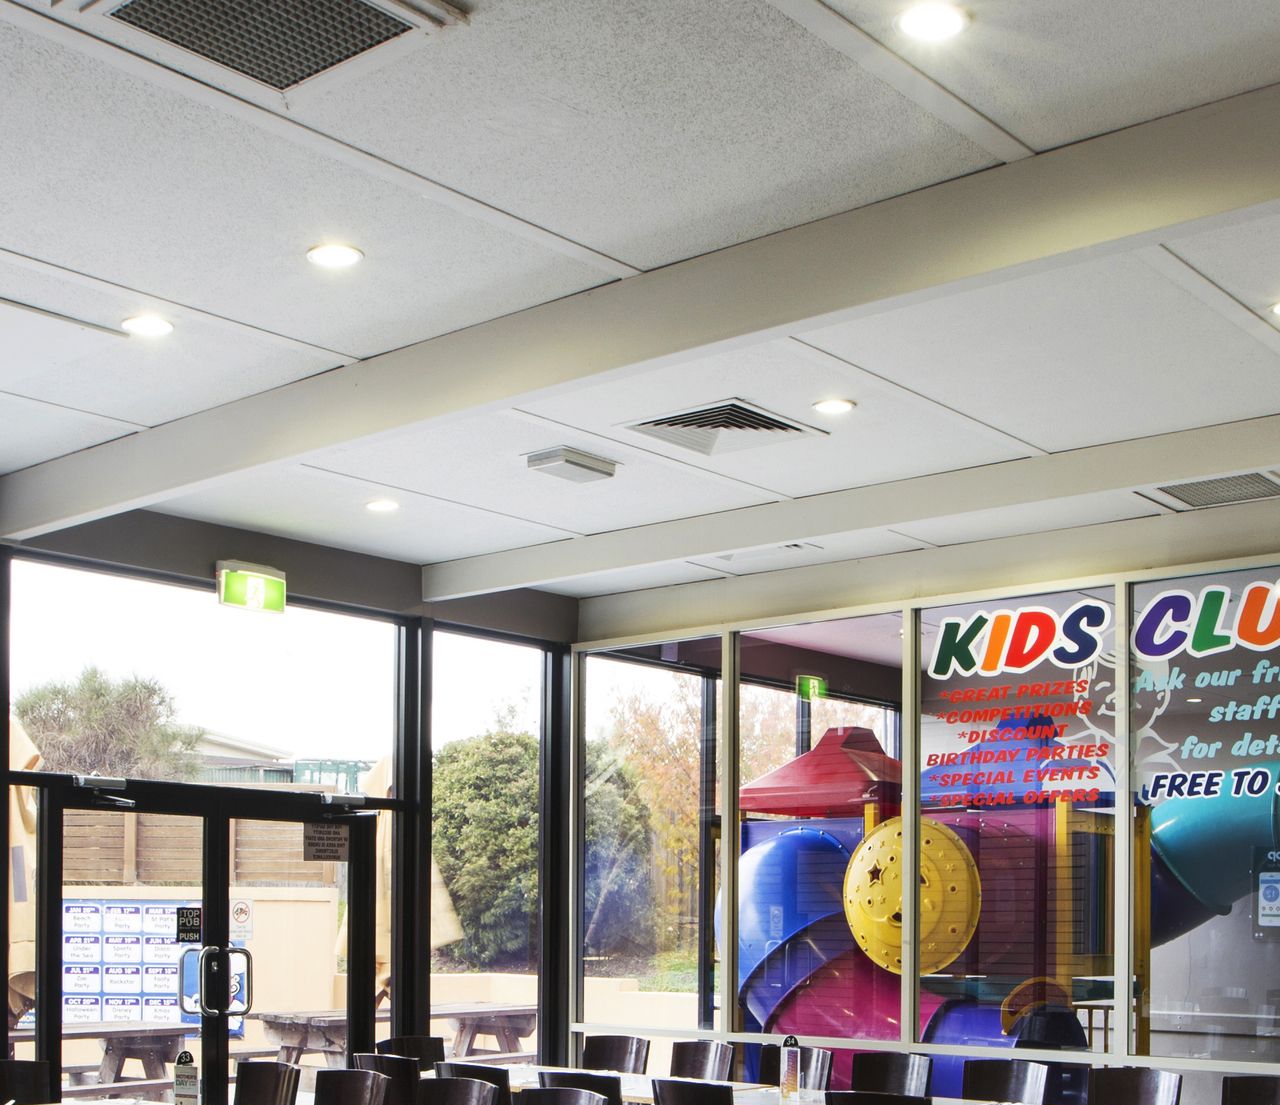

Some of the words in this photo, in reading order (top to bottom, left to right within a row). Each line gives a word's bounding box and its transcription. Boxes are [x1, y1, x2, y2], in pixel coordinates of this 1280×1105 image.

[927, 599, 1112, 681] KIDS
[1135, 666, 1186, 693] Ask
[1194, 667, 1242, 688] our
[1016, 680, 1089, 699] PRIZES
[926, 748, 1020, 767] BIRTHDAY
[1025, 743, 1110, 762] PARTIES
[1181, 735, 1222, 760] for
[1023, 766, 1101, 784] EVENTS
[1148, 770, 1223, 800] FREE
[1231, 768, 1271, 798] TO
[1024, 788, 1100, 805] OFFERS
[180, 918, 200, 926] PUB
[184, 909, 200, 918] TOP
[786, 1038, 795, 1046] 34
[180, 1052, 190, 1062] 33
